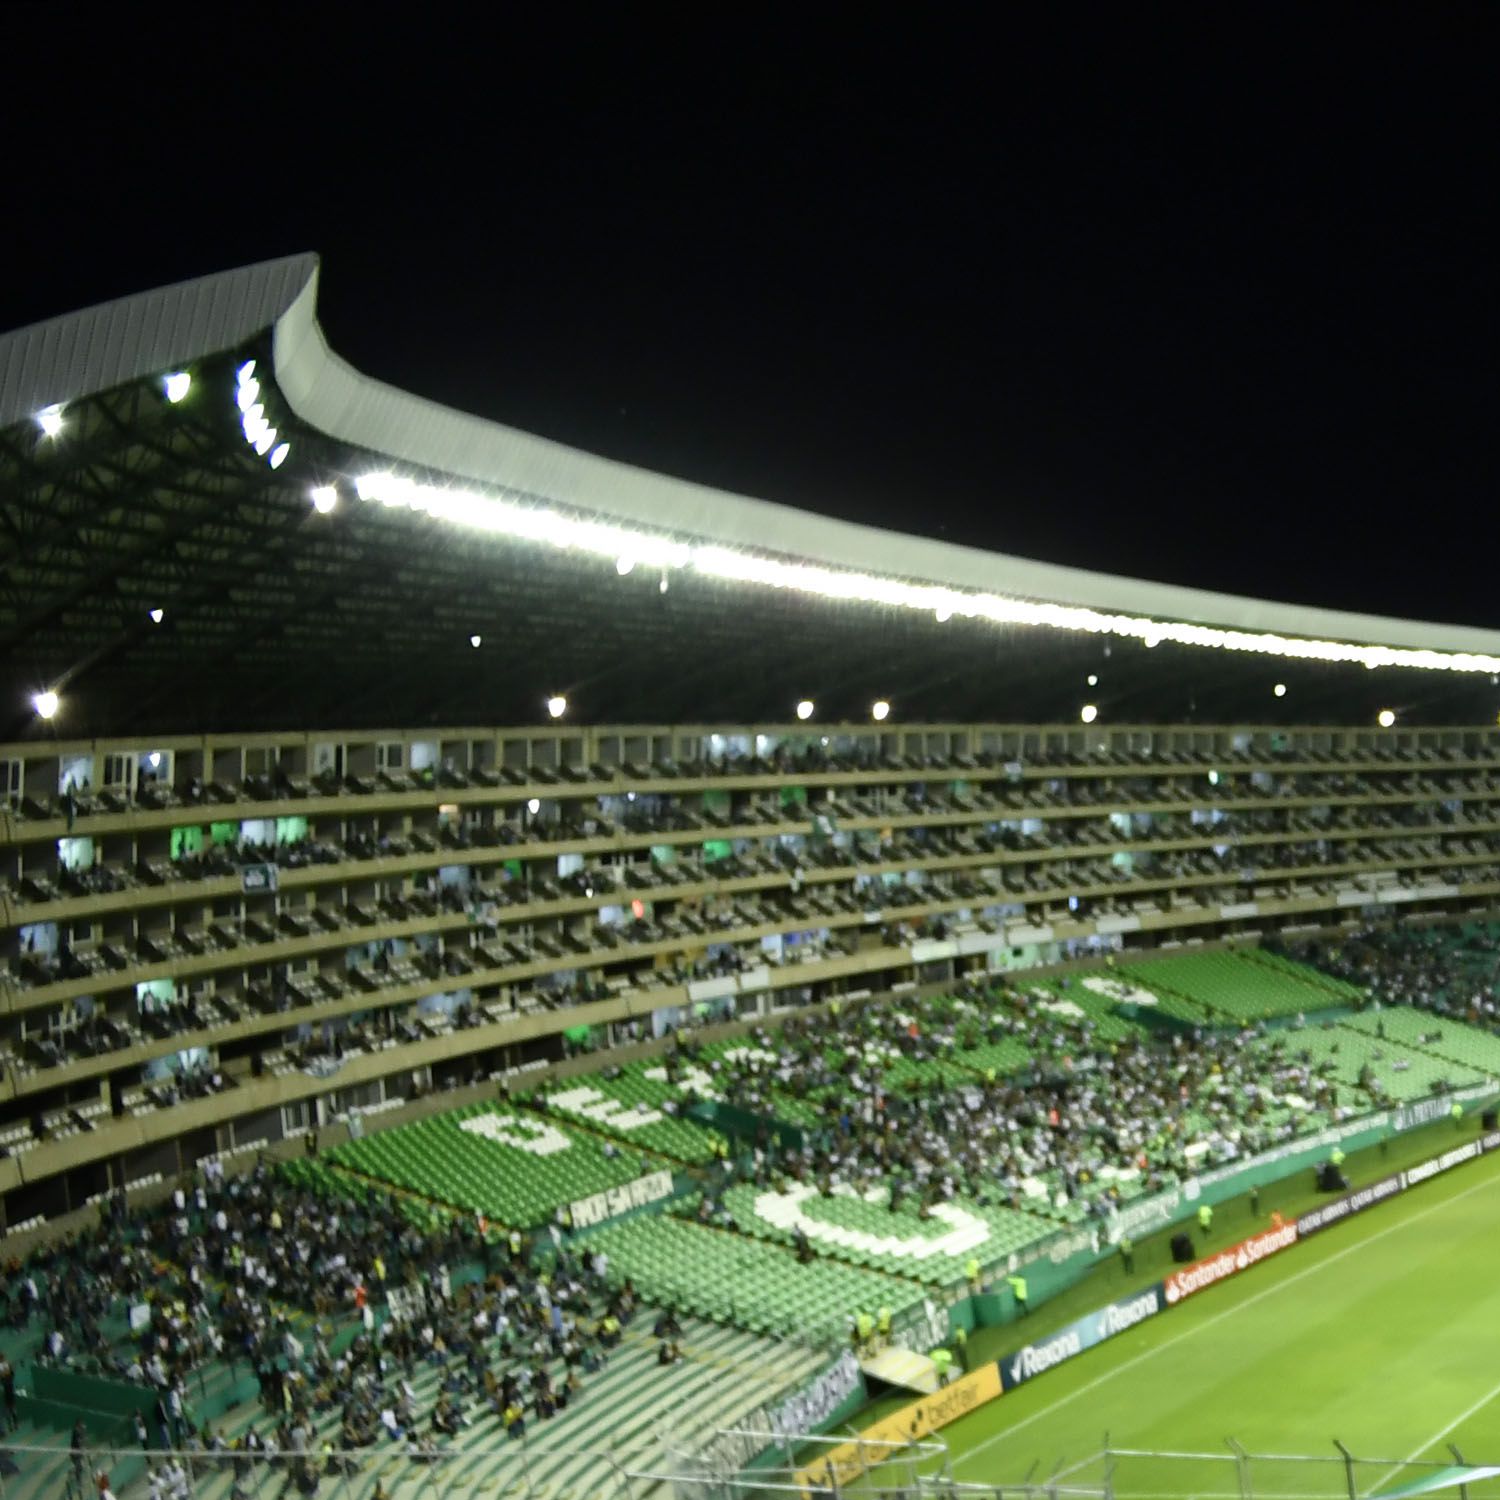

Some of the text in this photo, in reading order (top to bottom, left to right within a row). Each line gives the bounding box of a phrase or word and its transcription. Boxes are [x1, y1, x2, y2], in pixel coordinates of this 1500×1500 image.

[1178, 1223, 1297, 1297] Santander Santander
[1022, 1290, 1158, 1378] Rexona Rexona
